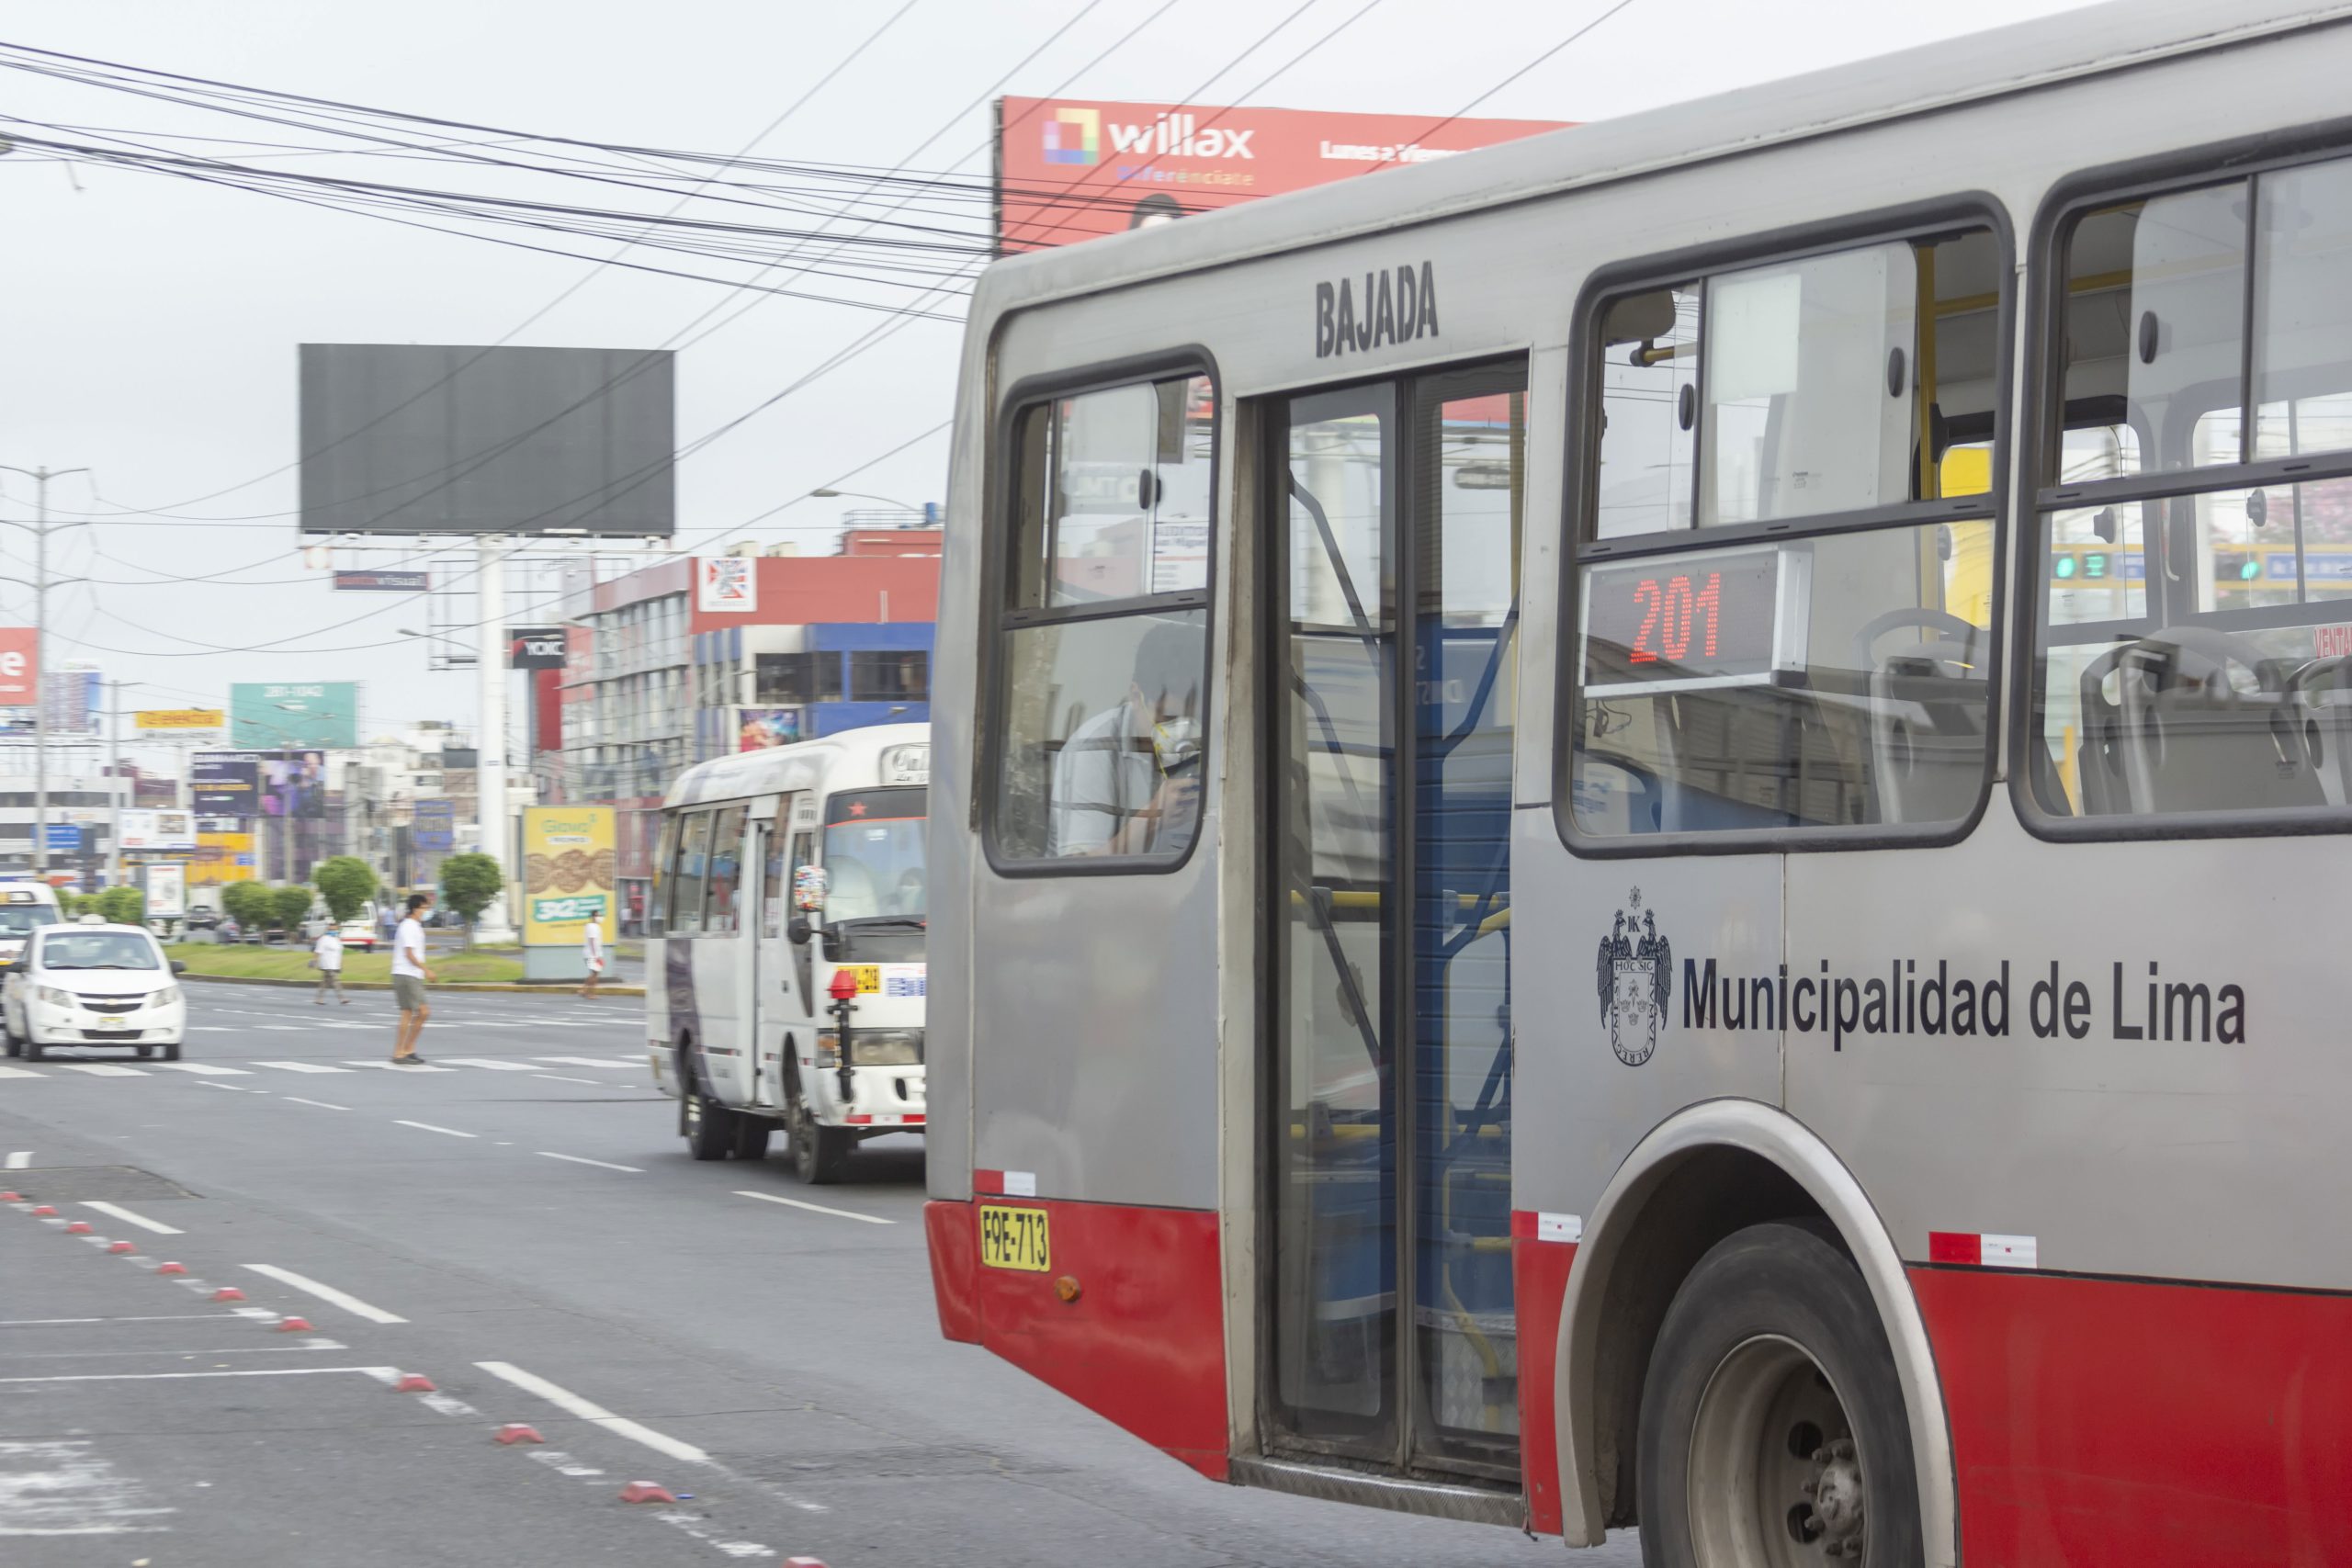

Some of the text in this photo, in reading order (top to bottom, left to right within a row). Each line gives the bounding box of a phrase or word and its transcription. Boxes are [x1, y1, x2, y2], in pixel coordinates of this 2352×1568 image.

[1107, 112, 1255, 159] willax
[1317, 260, 1439, 358] BAJADA
[1629, 572, 1721, 663] 201
[2314, 626, 2352, 659] VENTA
[1683, 957, 2246, 1053] Municipalidad de Lima
[983, 1210, 1047, 1267] F9E-713
